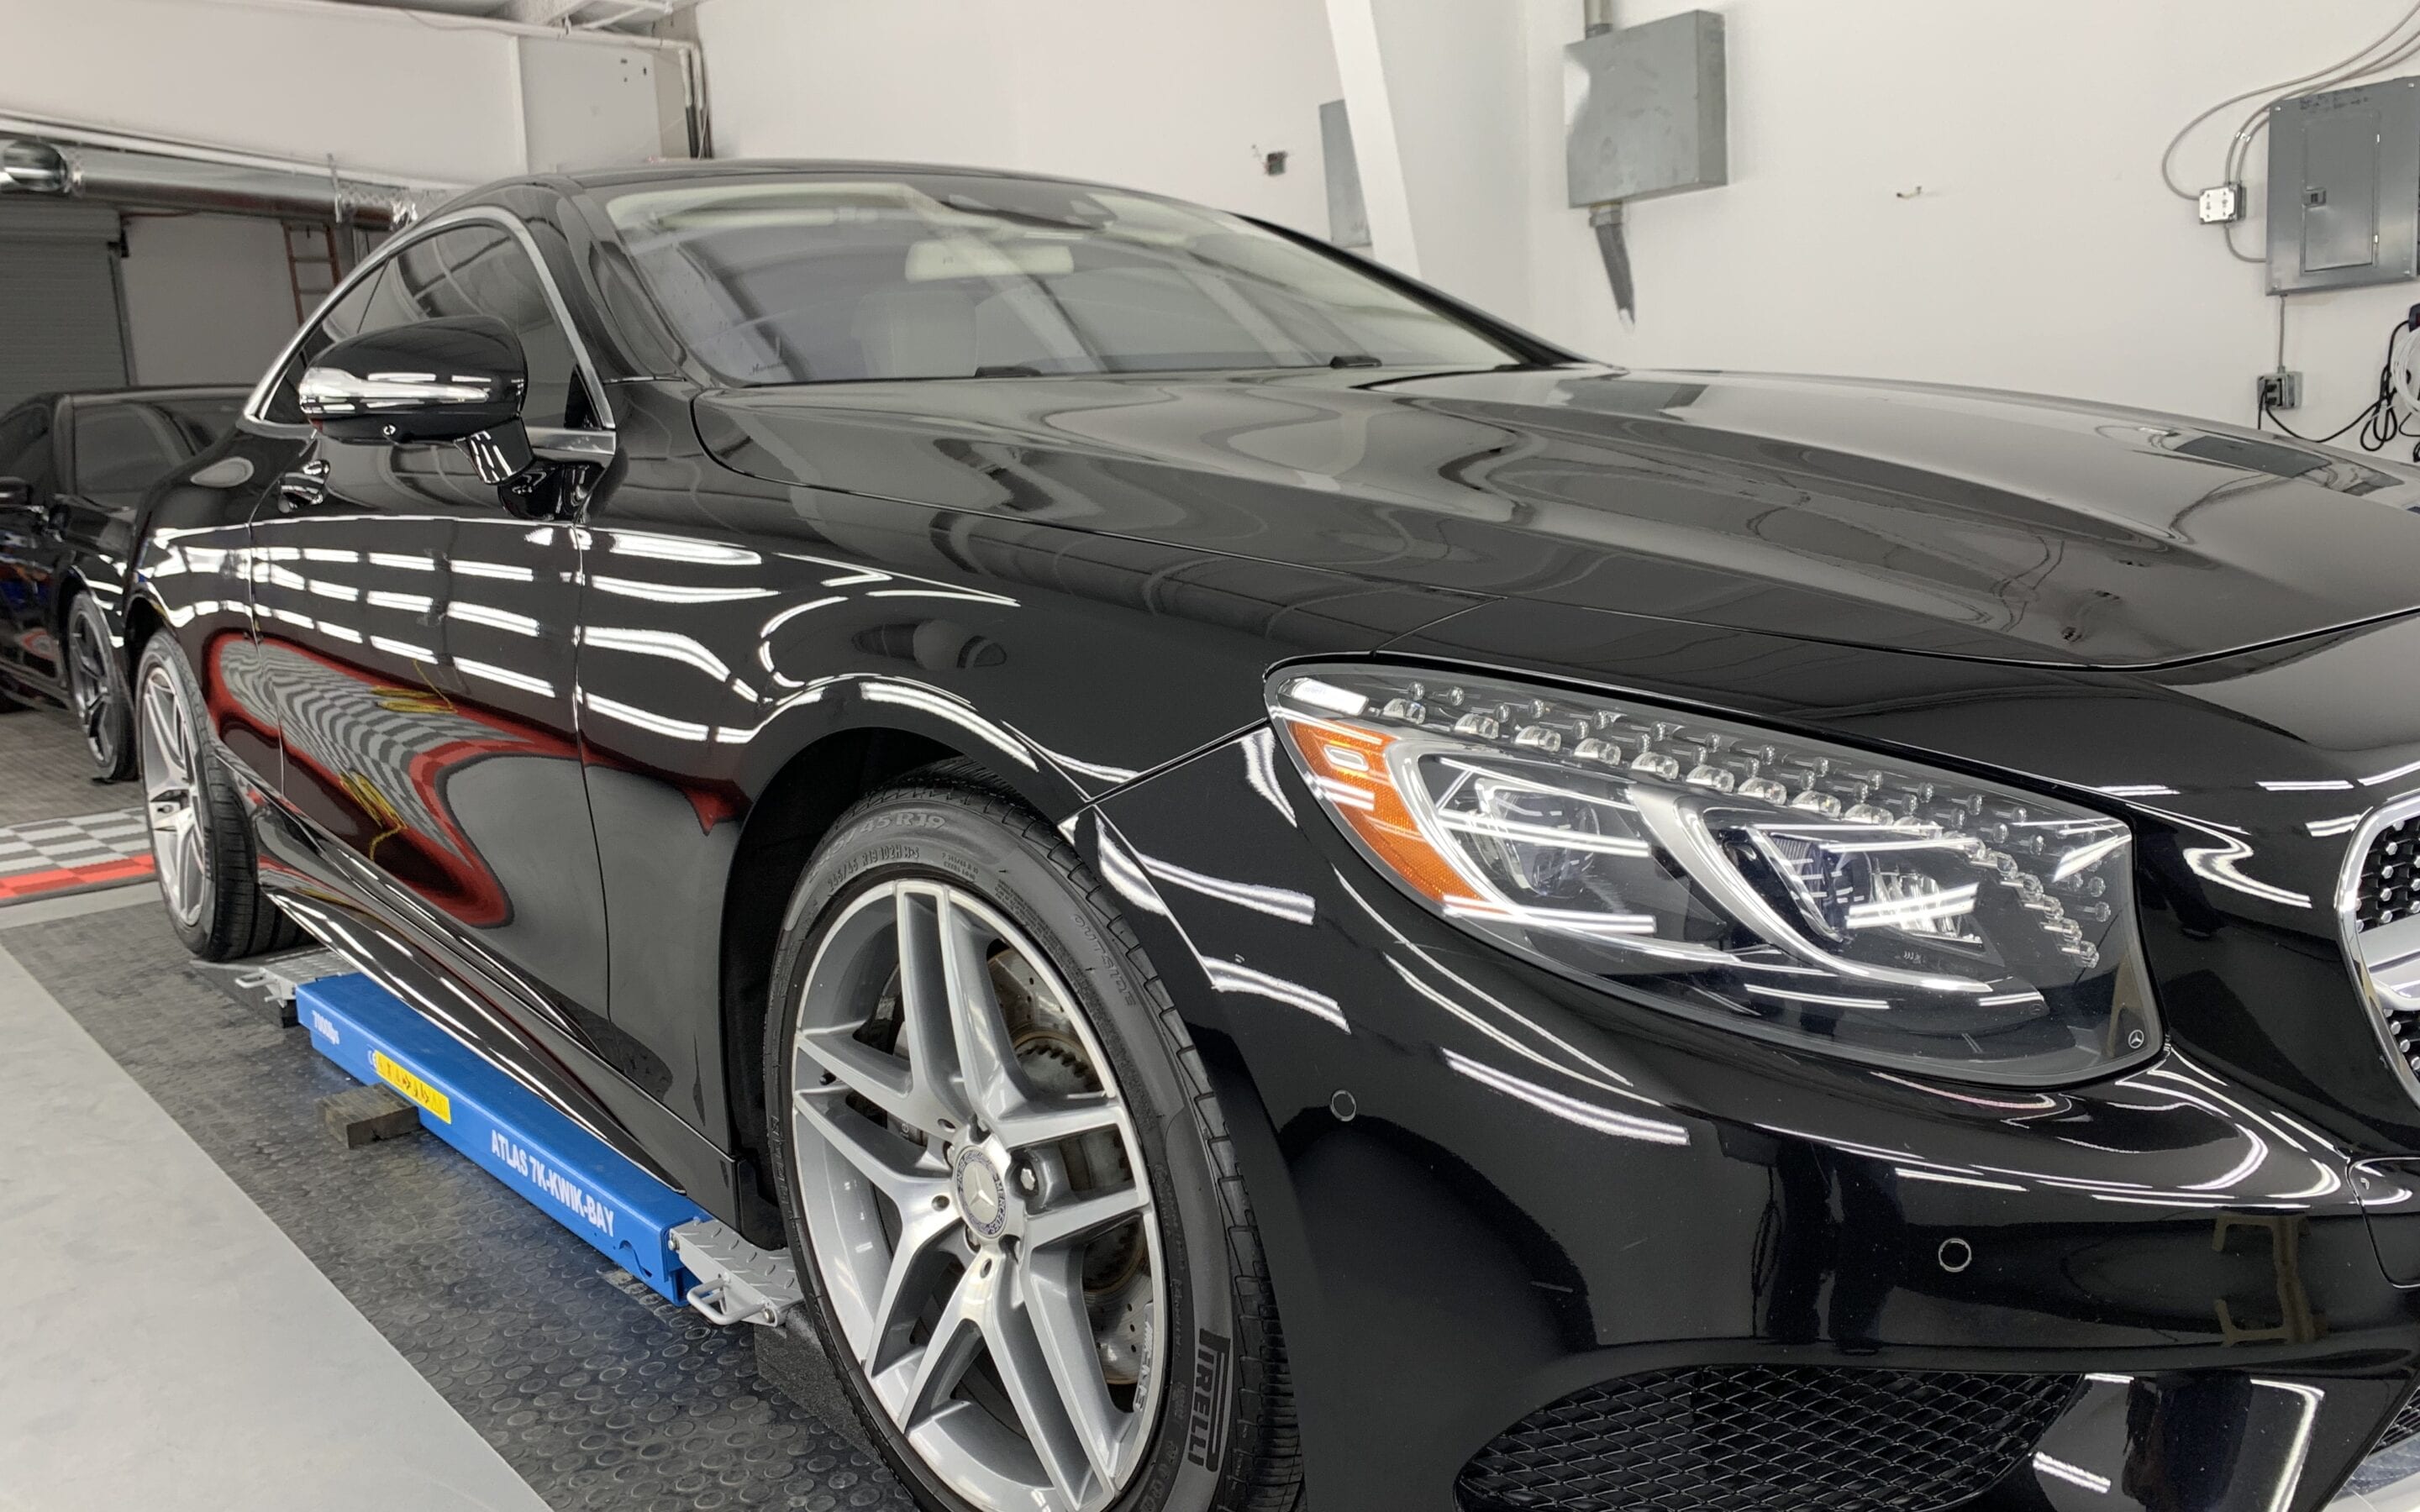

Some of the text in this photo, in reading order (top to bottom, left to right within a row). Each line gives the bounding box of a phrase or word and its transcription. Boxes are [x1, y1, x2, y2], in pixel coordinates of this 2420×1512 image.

[881, 844, 902, 860] 102H
[1071, 913, 1136, 1006] OUTSIDE
[492, 1129, 614, 1238] ATLAS 7K-KWIK-BAY
[988, 1179, 1006, 1235] MERCEDES
[1187, 1328, 1231, 1472] PIRELLI
